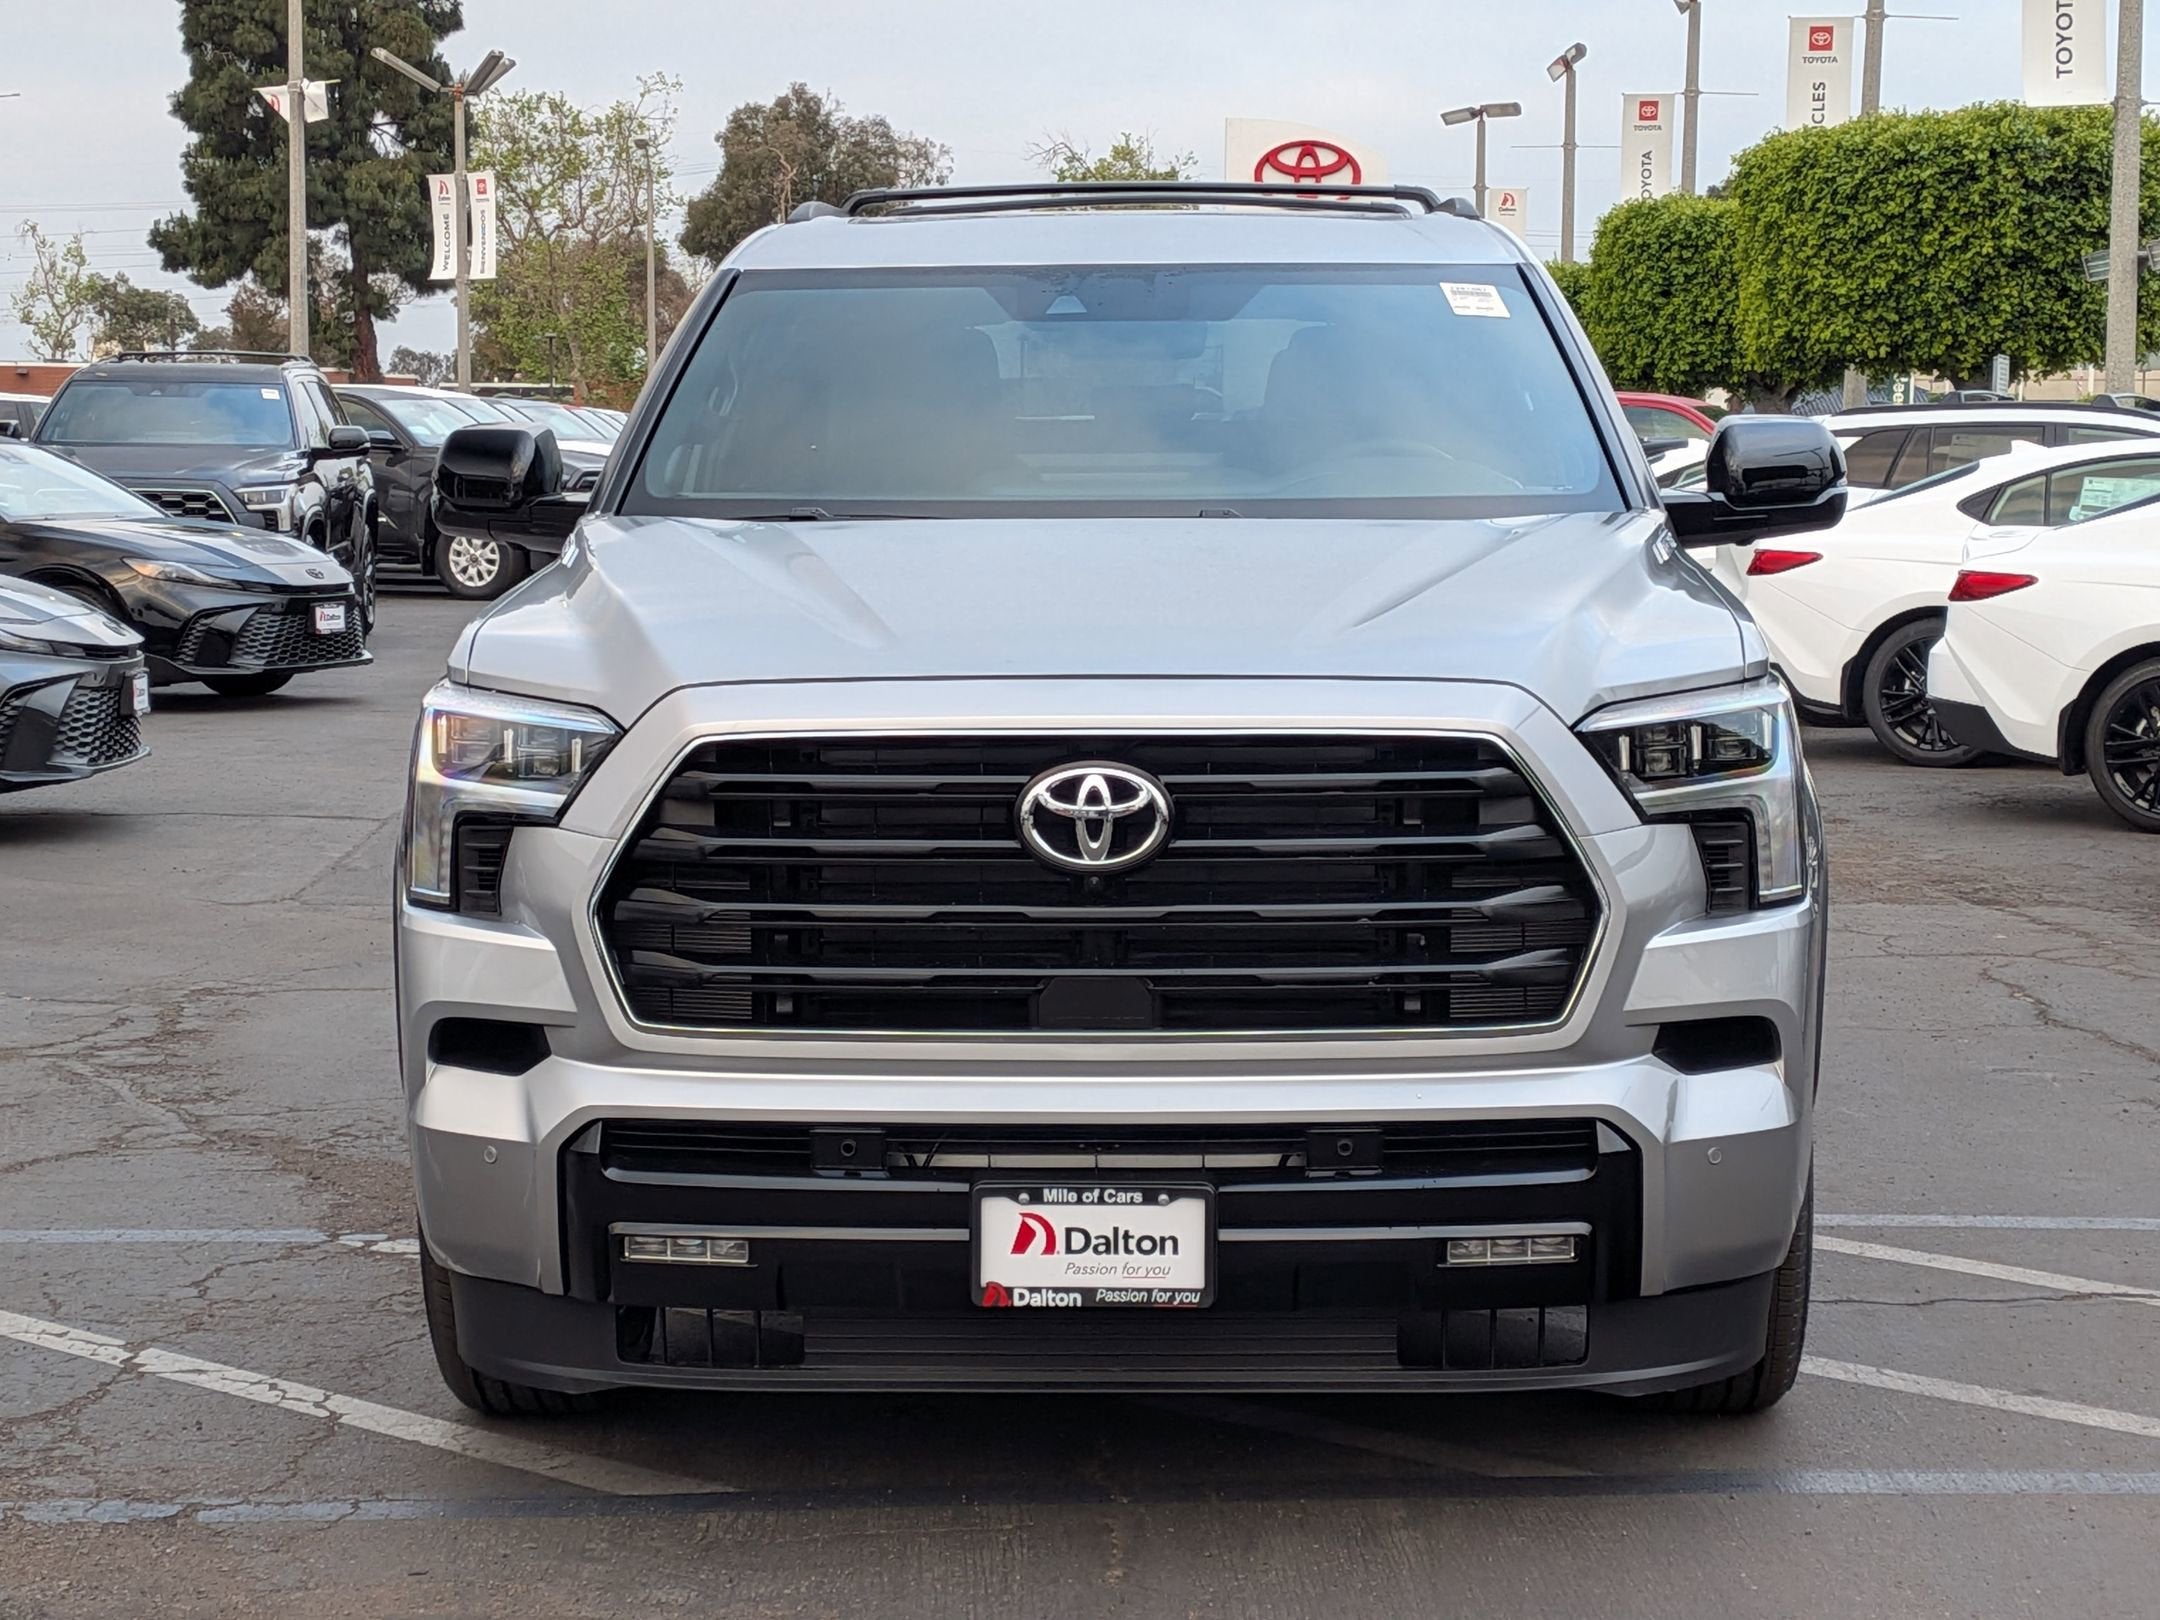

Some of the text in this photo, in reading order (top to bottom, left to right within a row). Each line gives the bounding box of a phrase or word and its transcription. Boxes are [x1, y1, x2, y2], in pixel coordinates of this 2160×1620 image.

[2056, 0, 2073, 79] TOYOT
[1802, 56, 1838, 64] TOYOTA
[442, 213, 451, 272] WELCOME
[1043, 1188, 1143, 1203] Mile of Cars
[1064, 1226, 1179, 1256] Dalton
[1064, 1261, 1171, 1278] Passion for you
[1013, 1288, 1082, 1307] Dalton
[1096, 1288, 1201, 1306] Passion for you
